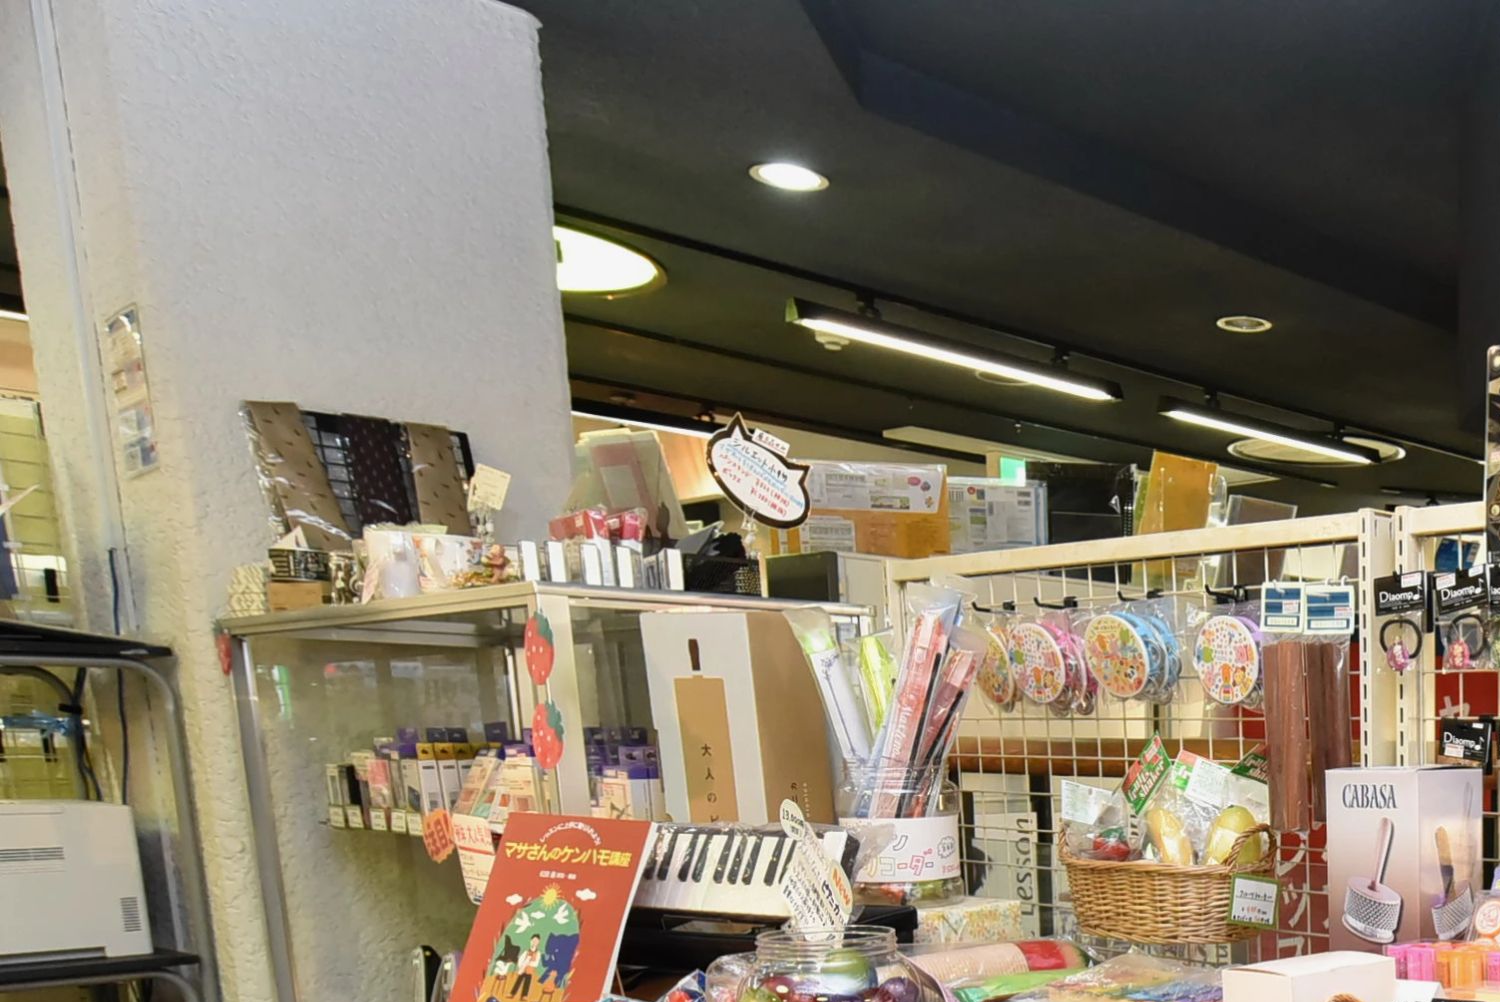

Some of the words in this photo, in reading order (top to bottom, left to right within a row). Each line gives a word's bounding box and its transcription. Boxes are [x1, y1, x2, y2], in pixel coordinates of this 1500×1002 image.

[1379, 590, 1413, 603] Diaomp
[1441, 586, 1475, 601] Diaomp
[1443, 731, 1475, 749] Diaomp
[1342, 783, 1398, 809] CABASA
[504, 841, 633, 868] マサさんのケンハモ講座
